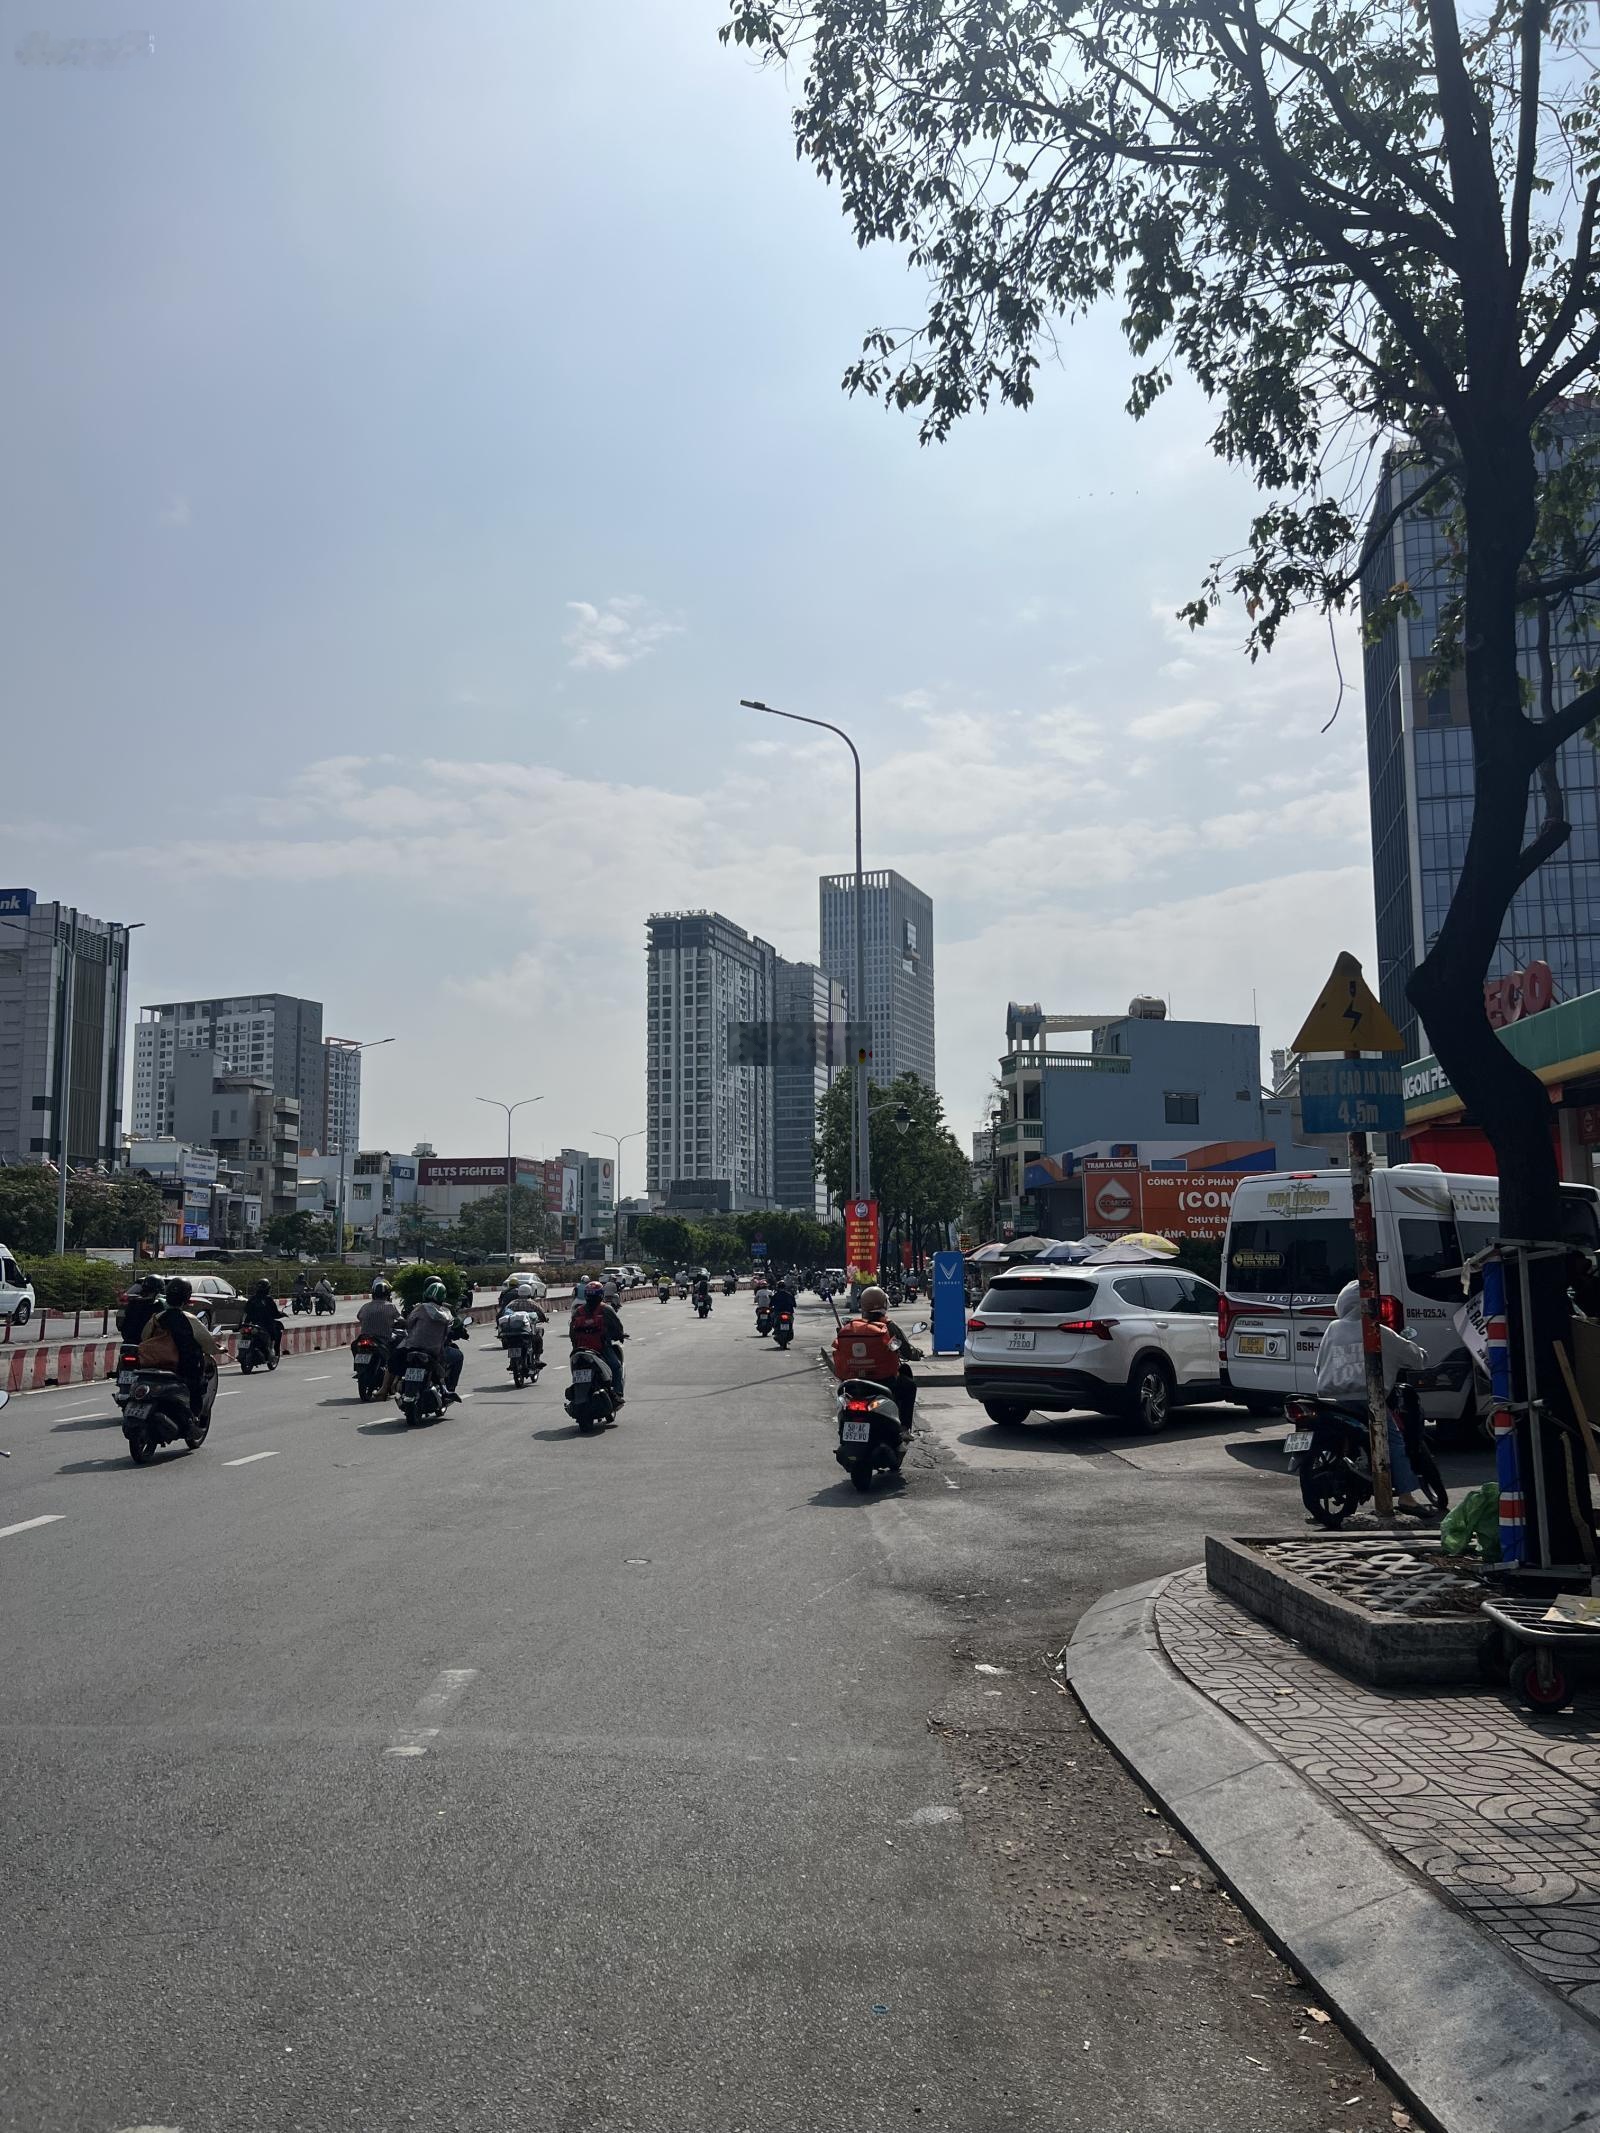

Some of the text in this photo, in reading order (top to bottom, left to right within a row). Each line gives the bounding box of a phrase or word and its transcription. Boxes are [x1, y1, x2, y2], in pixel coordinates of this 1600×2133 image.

[428, 1167, 457, 1177] IELTS
[1147, 1177, 1174, 1186] CÔNG
[1452, 1190, 1499, 1212] HÙN
